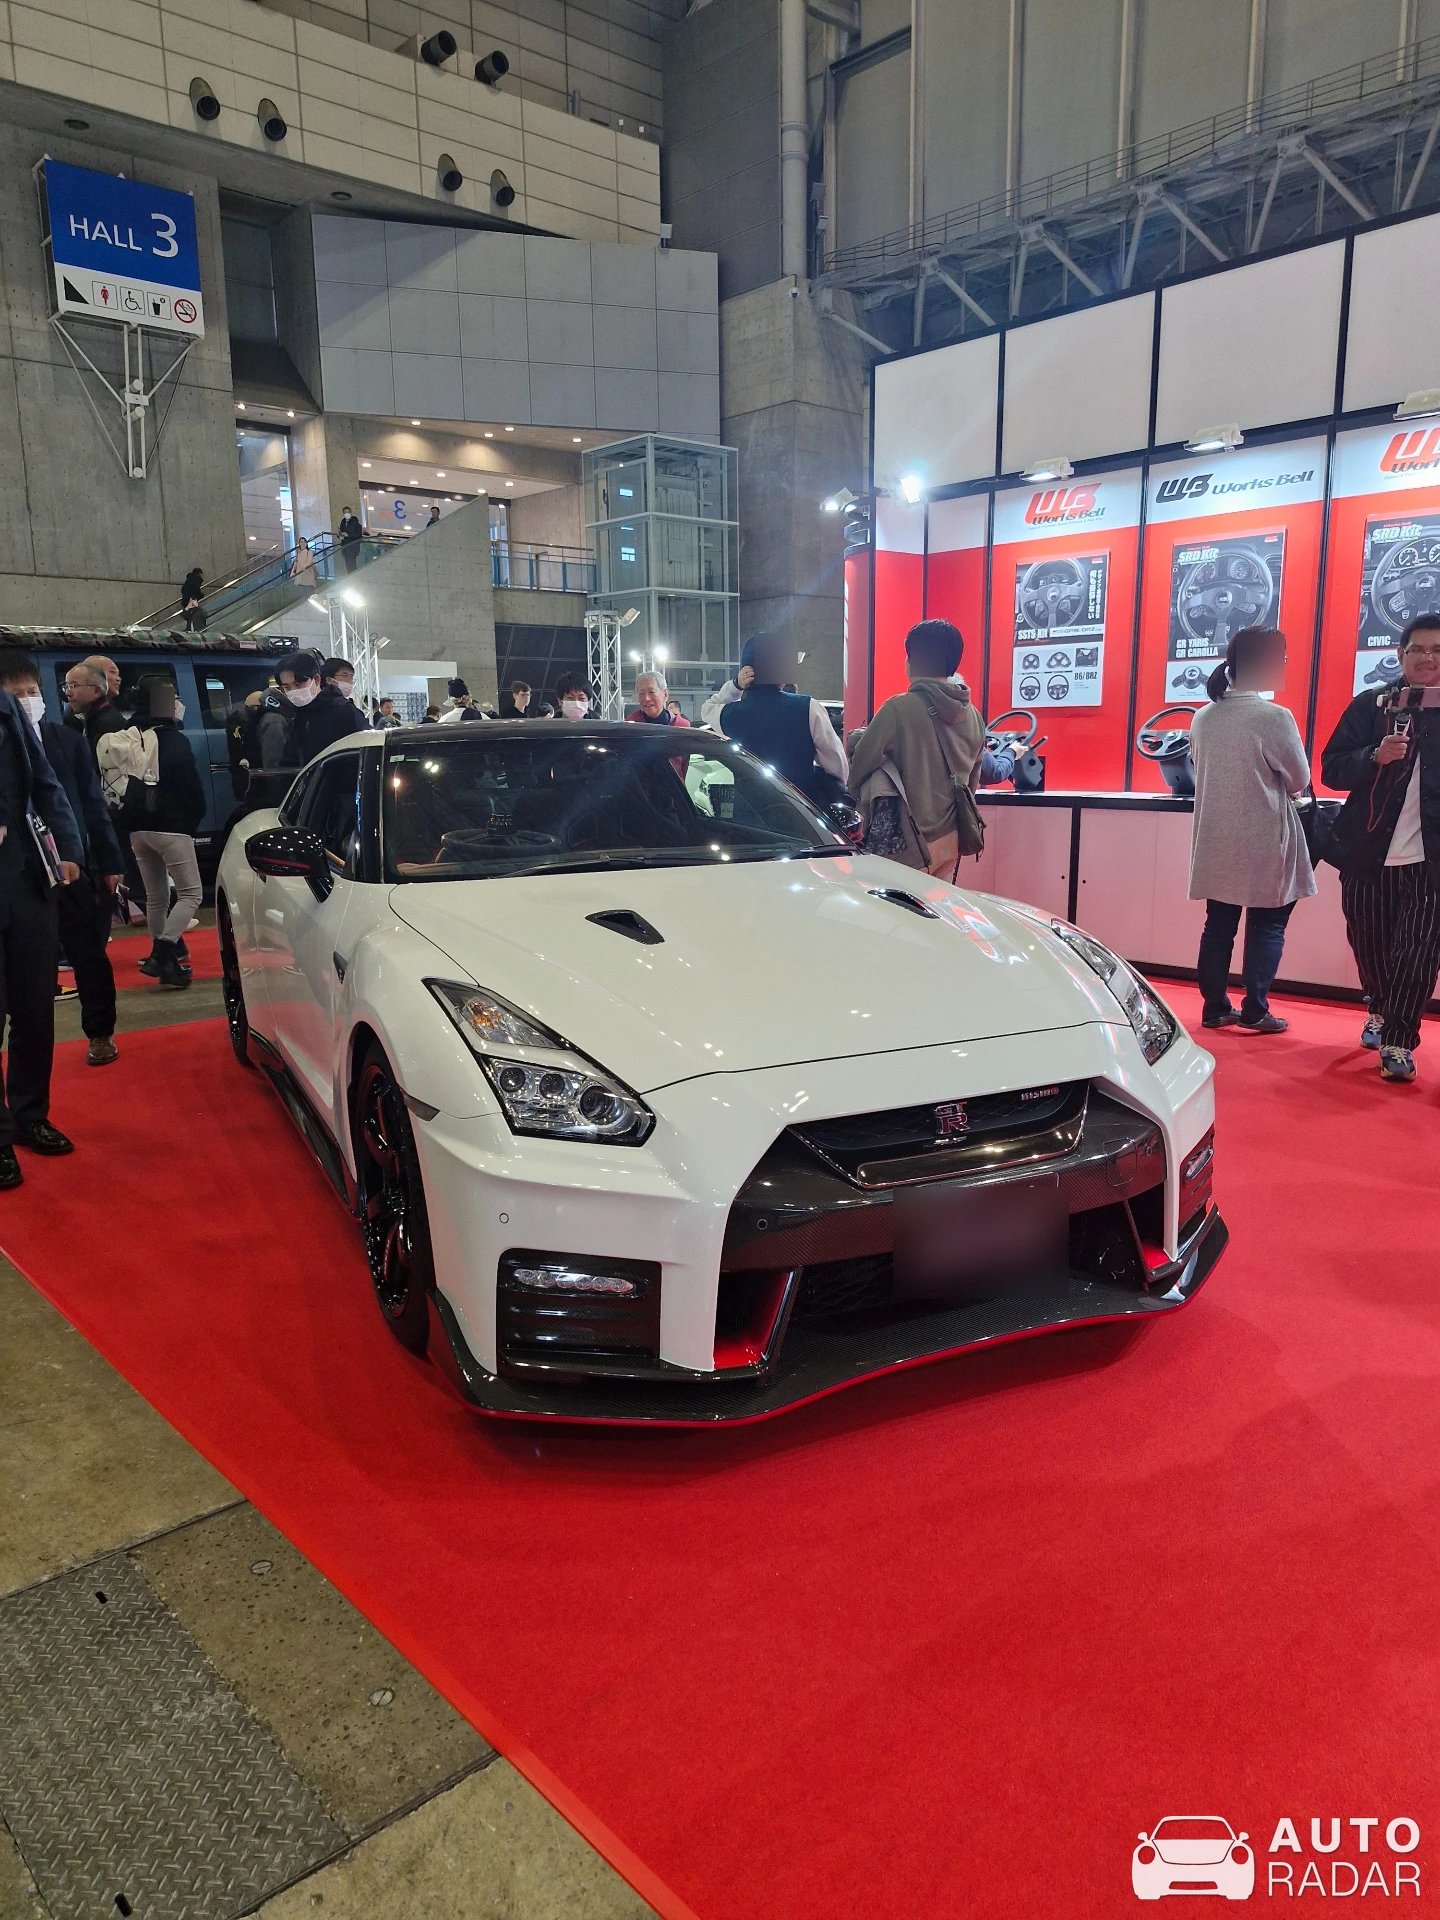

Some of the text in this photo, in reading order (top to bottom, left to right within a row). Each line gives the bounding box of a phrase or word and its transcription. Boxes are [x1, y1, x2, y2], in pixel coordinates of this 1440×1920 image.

[69, 213, 179, 258] HALL 3
[1212, 478, 1274, 495] Works
[1275, 470, 1315, 486] Bell
[1032, 507, 1106, 526] Works Bell
[1372, 527, 1400, 541] SRD
[1178, 550, 1201, 562] SRD
[1017, 629, 1036, 640] SSTS
[1176, 637, 1210, 649] GR YARIS
[1367, 635, 1391, 647] CIVIC
[1175, 649, 1187, 658] GR
